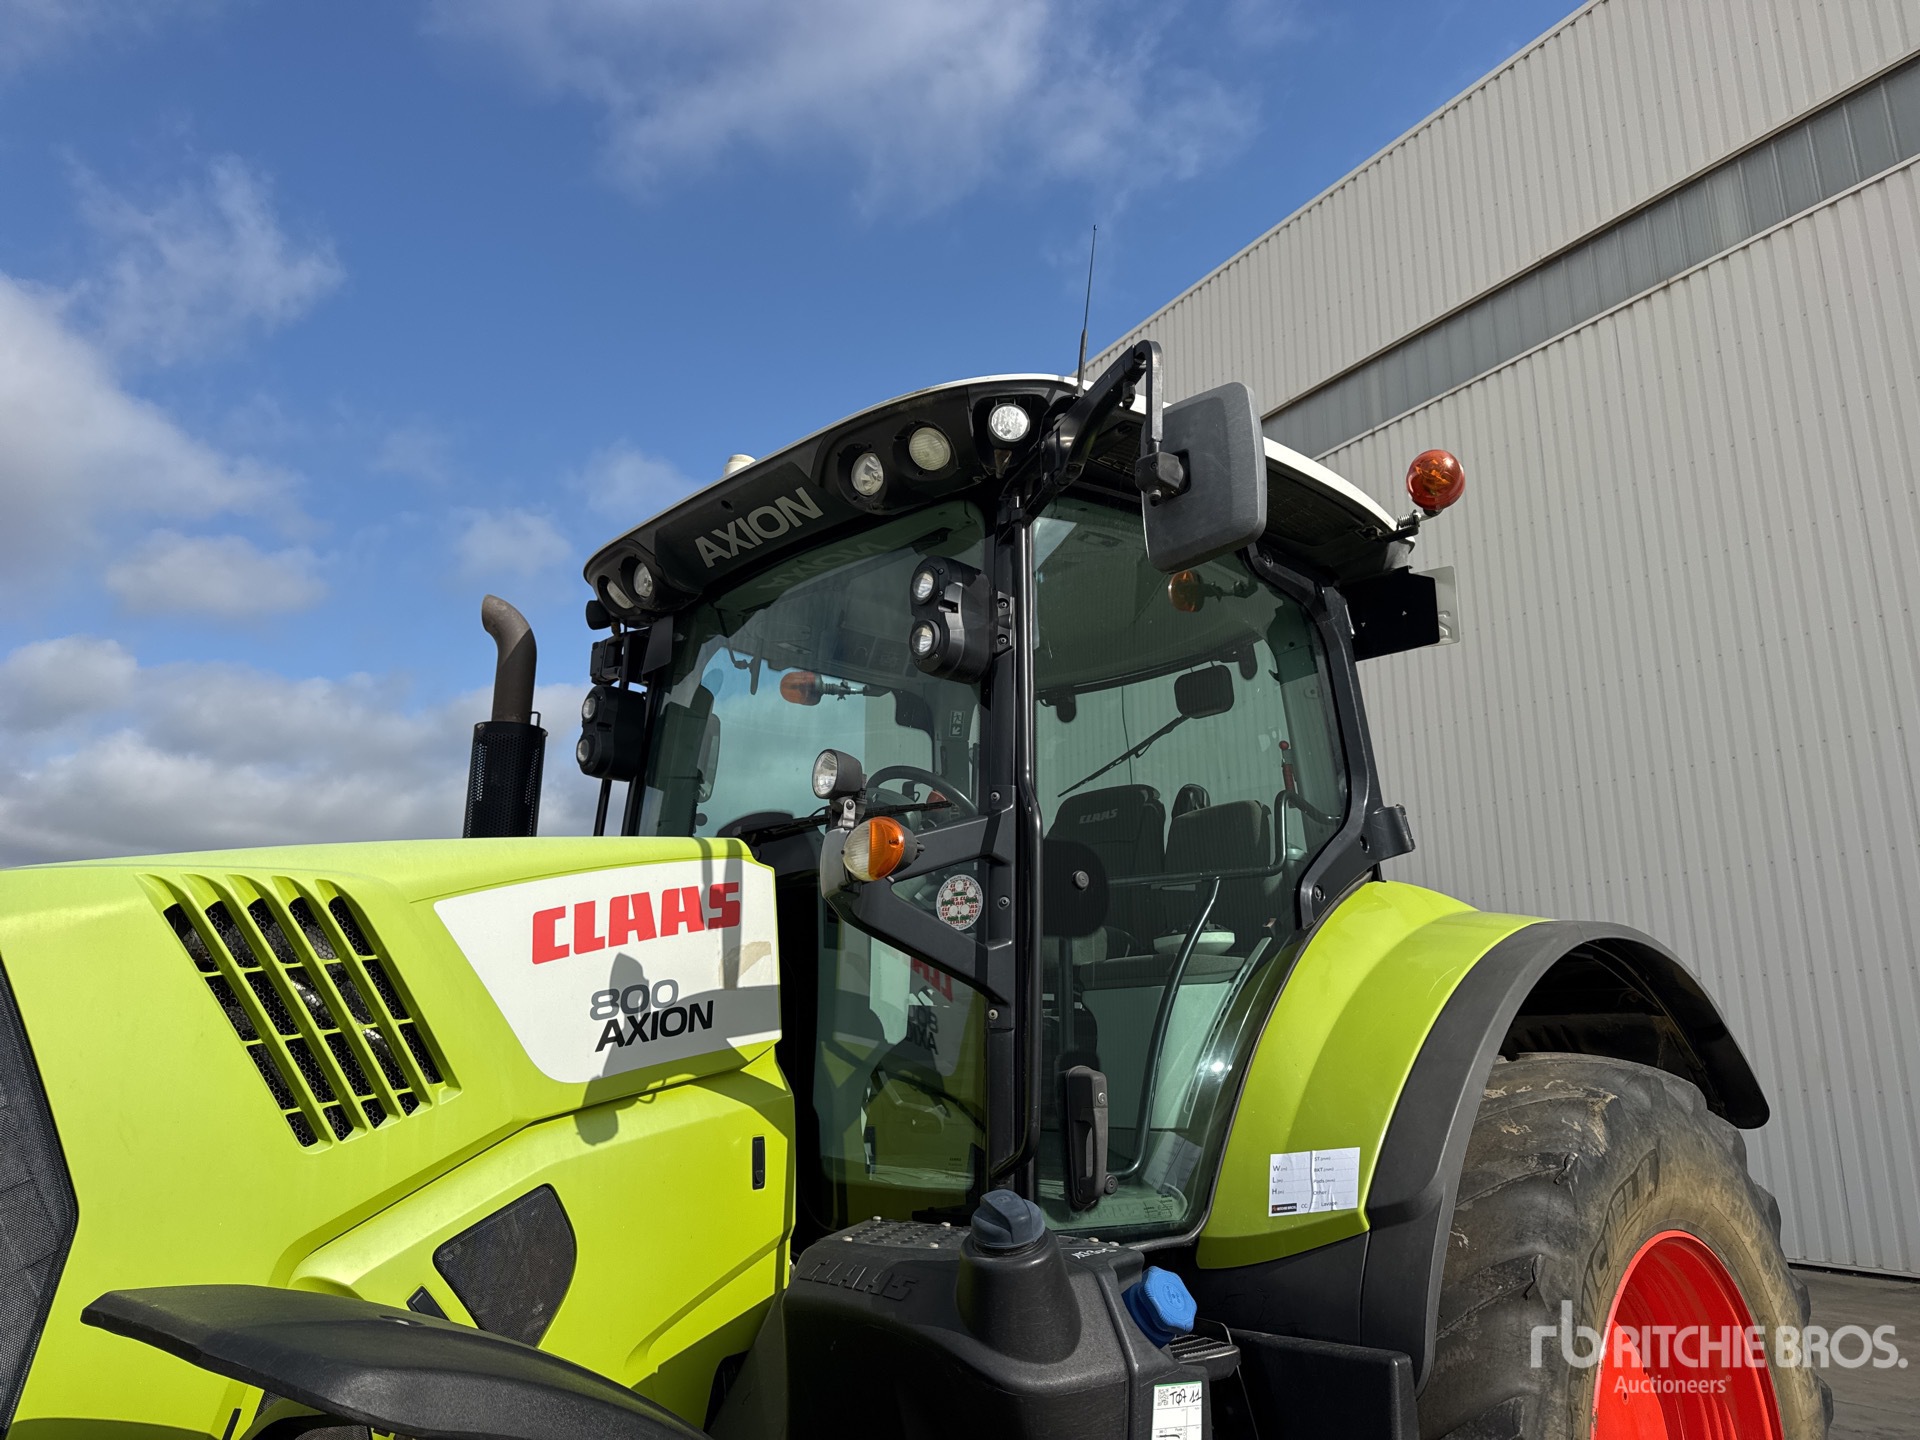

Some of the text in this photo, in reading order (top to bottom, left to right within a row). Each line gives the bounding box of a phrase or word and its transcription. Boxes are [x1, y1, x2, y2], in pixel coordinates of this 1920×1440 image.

[695, 487, 824, 569] AXION
[532, 882, 741, 965] CLAAS
[590, 979, 679, 1021] 800
[595, 1000, 714, 1052] AXION
